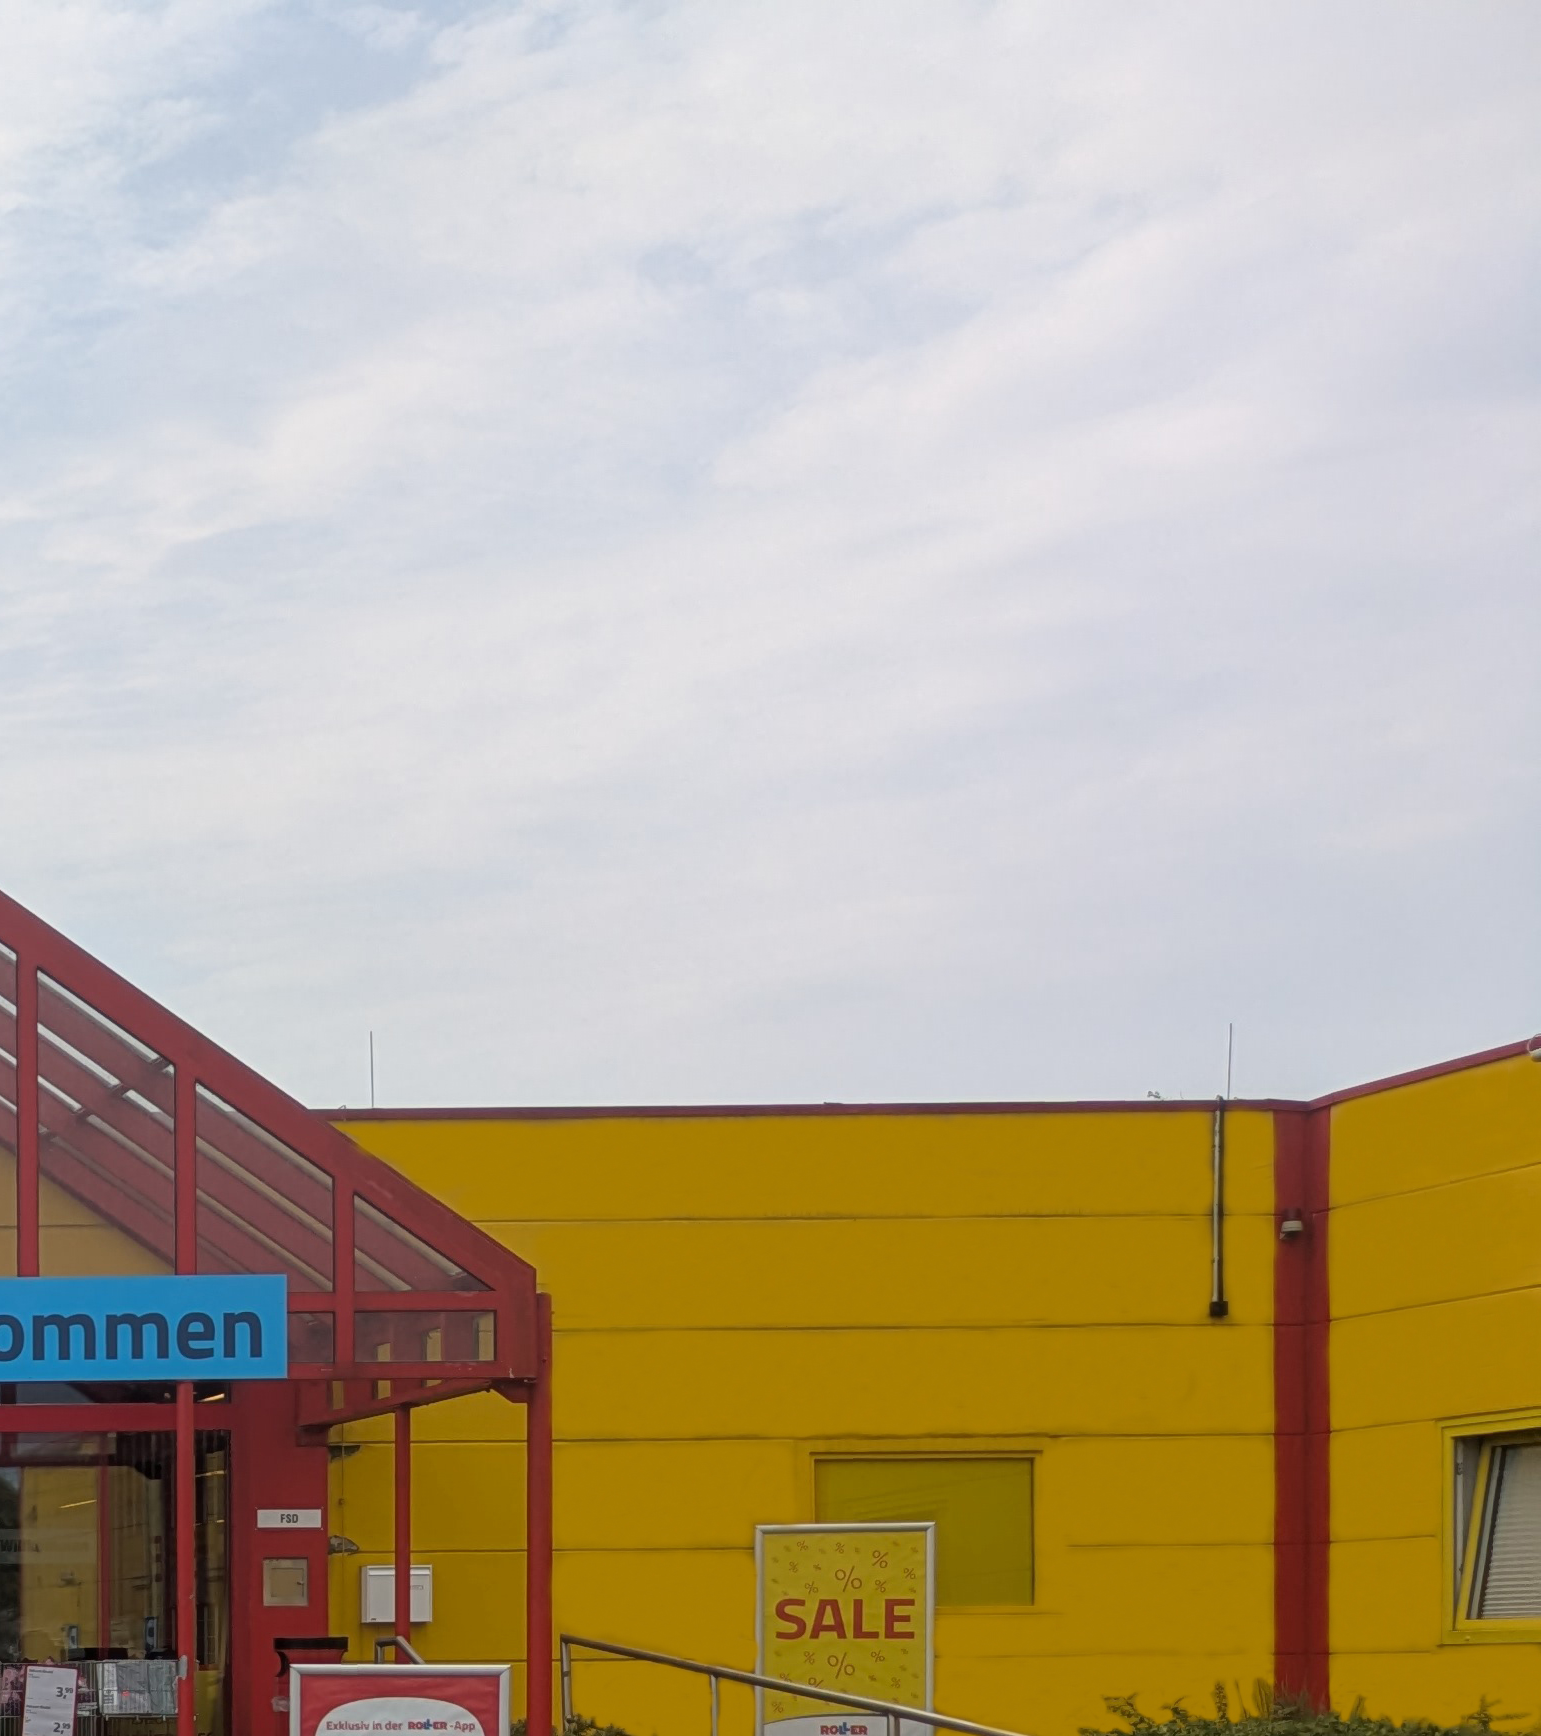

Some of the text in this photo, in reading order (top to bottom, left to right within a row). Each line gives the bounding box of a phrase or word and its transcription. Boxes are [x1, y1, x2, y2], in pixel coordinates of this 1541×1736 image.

[280, 1514, 299, 1523] FSD
[775, 1598, 915, 1639] SALE
[326, 1721, 370, 1730] Exklusiv
[372, 1720, 383, 1730] in
[385, 1720, 403, 1730] der
[407, 1718, 448, 1730] ROLLER
[820, 1722, 868, 1735] ROLLER
